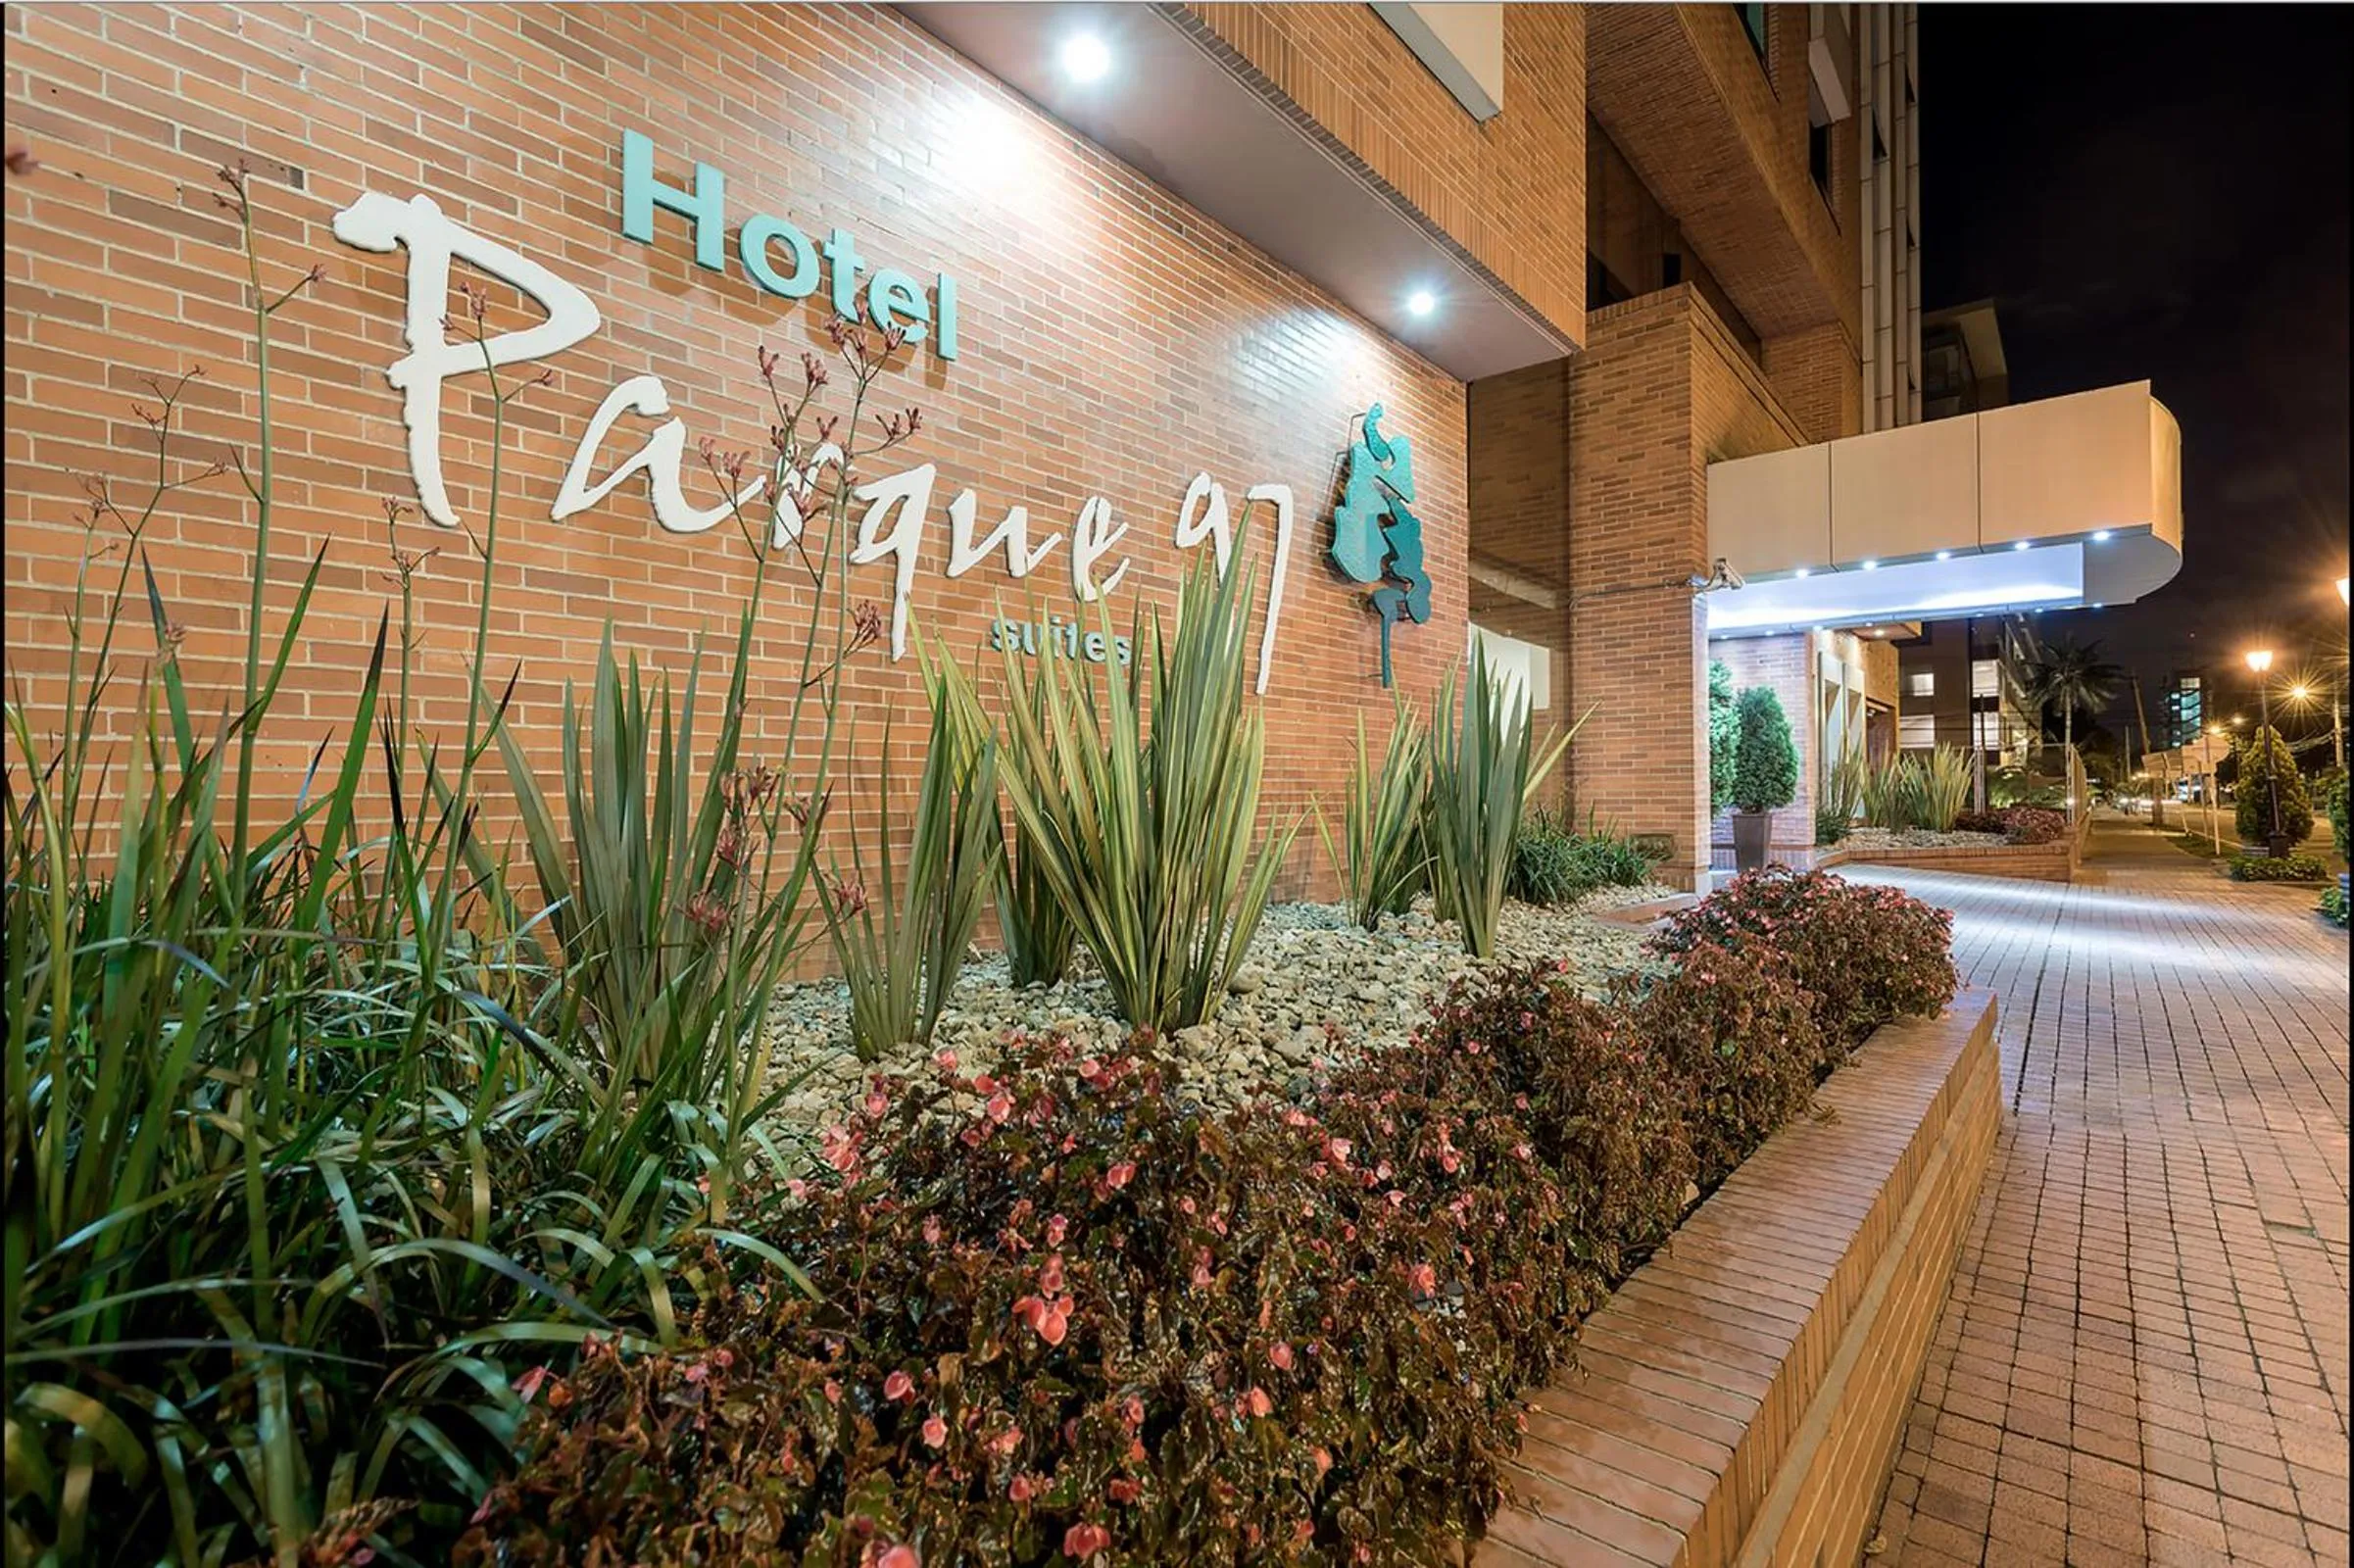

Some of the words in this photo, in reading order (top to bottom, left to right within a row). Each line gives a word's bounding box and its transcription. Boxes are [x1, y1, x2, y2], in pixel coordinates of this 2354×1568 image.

[621, 126, 959, 363] Hotel
[331, 191, 1130, 663] Parque
[1175, 470, 1294, 696] 97
[991, 615, 1133, 667] suites
